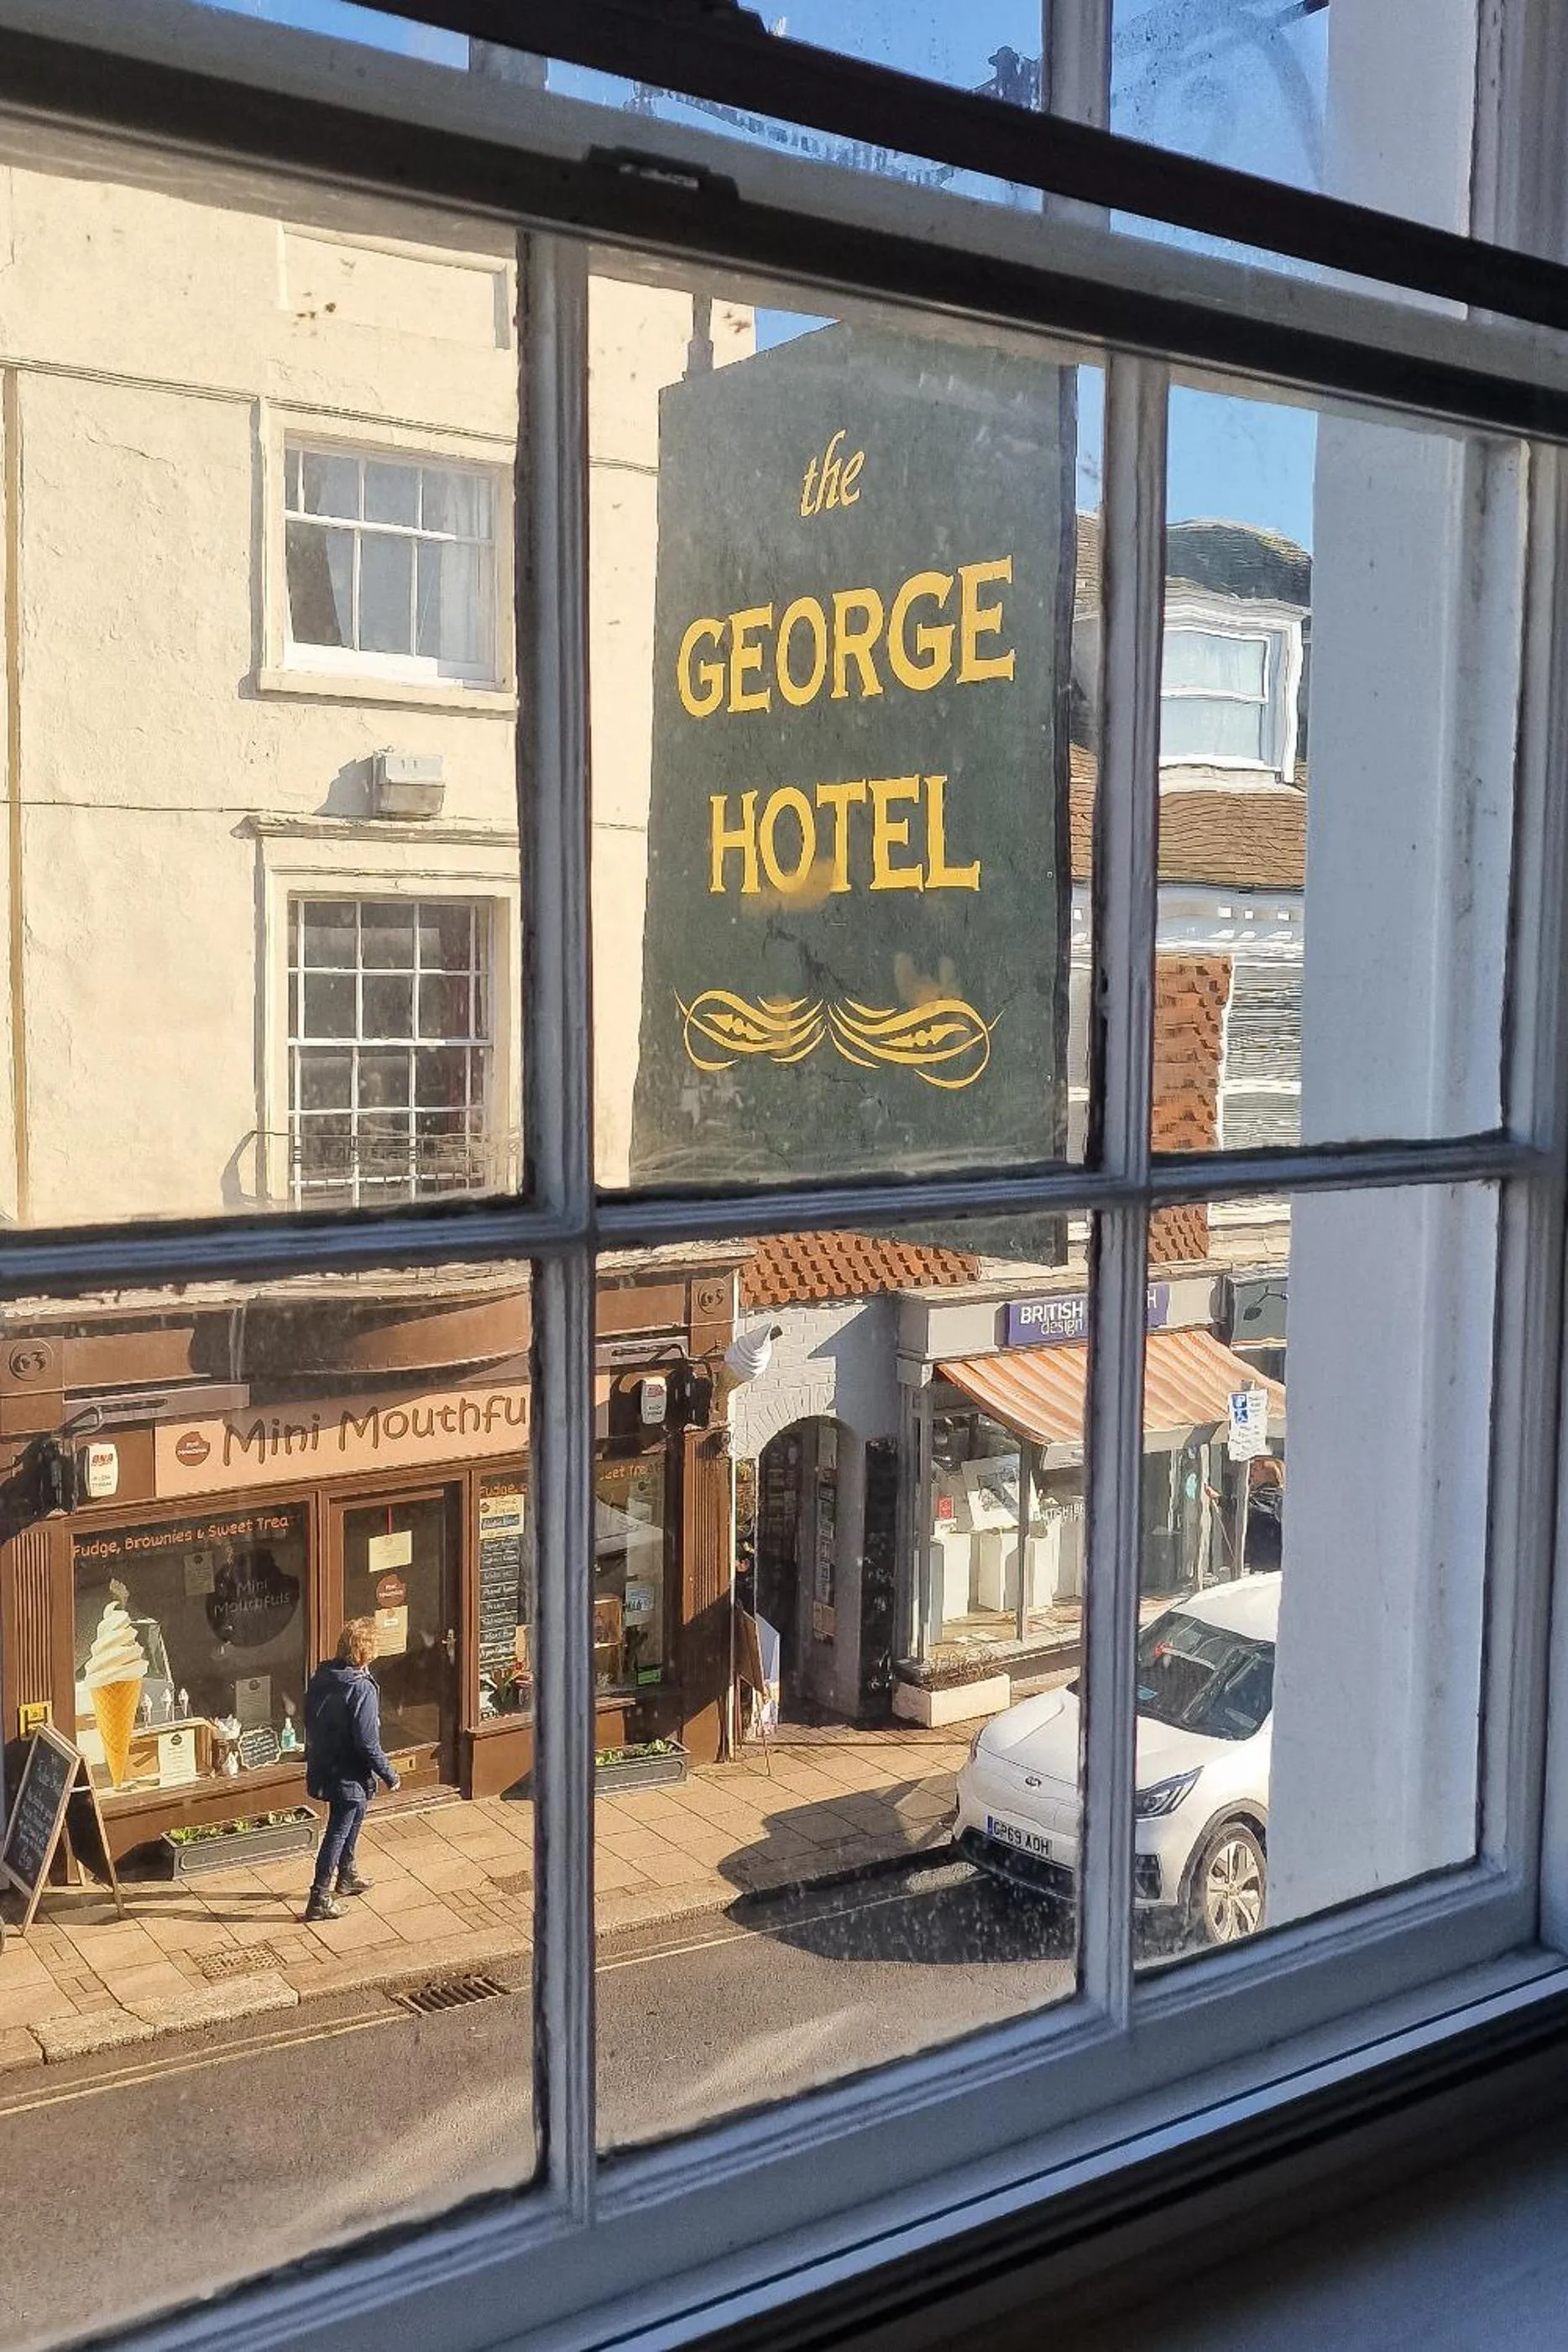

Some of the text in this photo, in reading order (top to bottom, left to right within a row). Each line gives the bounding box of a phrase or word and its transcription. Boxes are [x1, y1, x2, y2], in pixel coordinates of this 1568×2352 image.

[799, 429, 866, 518] the
[677, 554, 1016, 718] GEORGE
[708, 775, 981, 895] HOTEL
[1020, 1300, 1083, 1325] BRITISH
[1040, 1317, 1083, 1336] design
[222, 1413, 321, 1466] Mini
[73, 1539, 121, 1559] Fudge,
[125, 1528, 192, 1551] Brownies
[208, 1518, 253, 1539] Sweet
[236, 1579, 269, 1596] Mini
